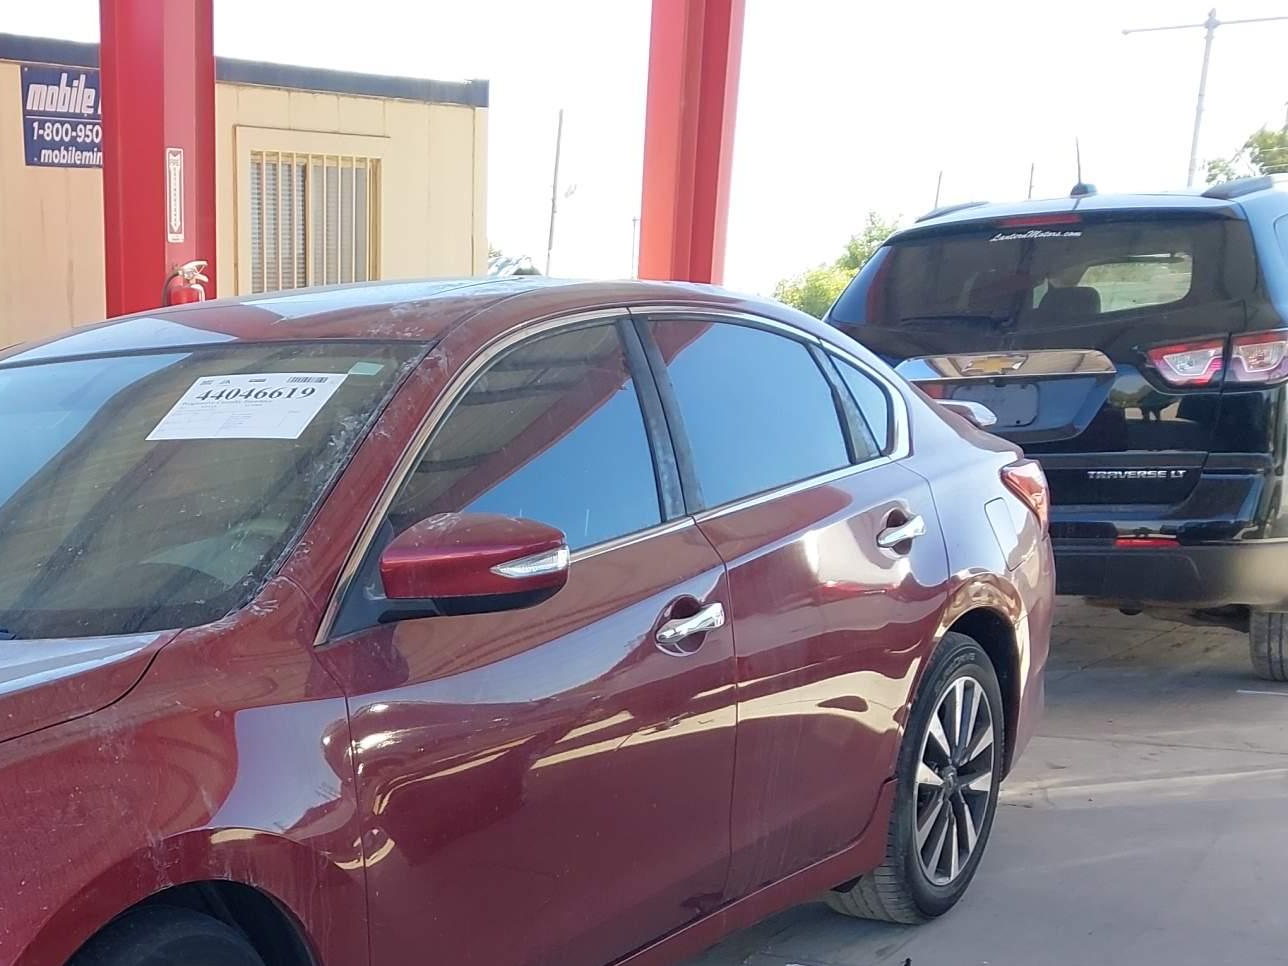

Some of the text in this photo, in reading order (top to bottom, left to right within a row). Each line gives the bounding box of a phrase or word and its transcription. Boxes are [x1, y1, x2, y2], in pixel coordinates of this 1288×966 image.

[26, 72, 96, 114] mobile
[196, 386, 316, 401] 44046619
[1087, 469, 1187, 479] TRAVERSE LT
